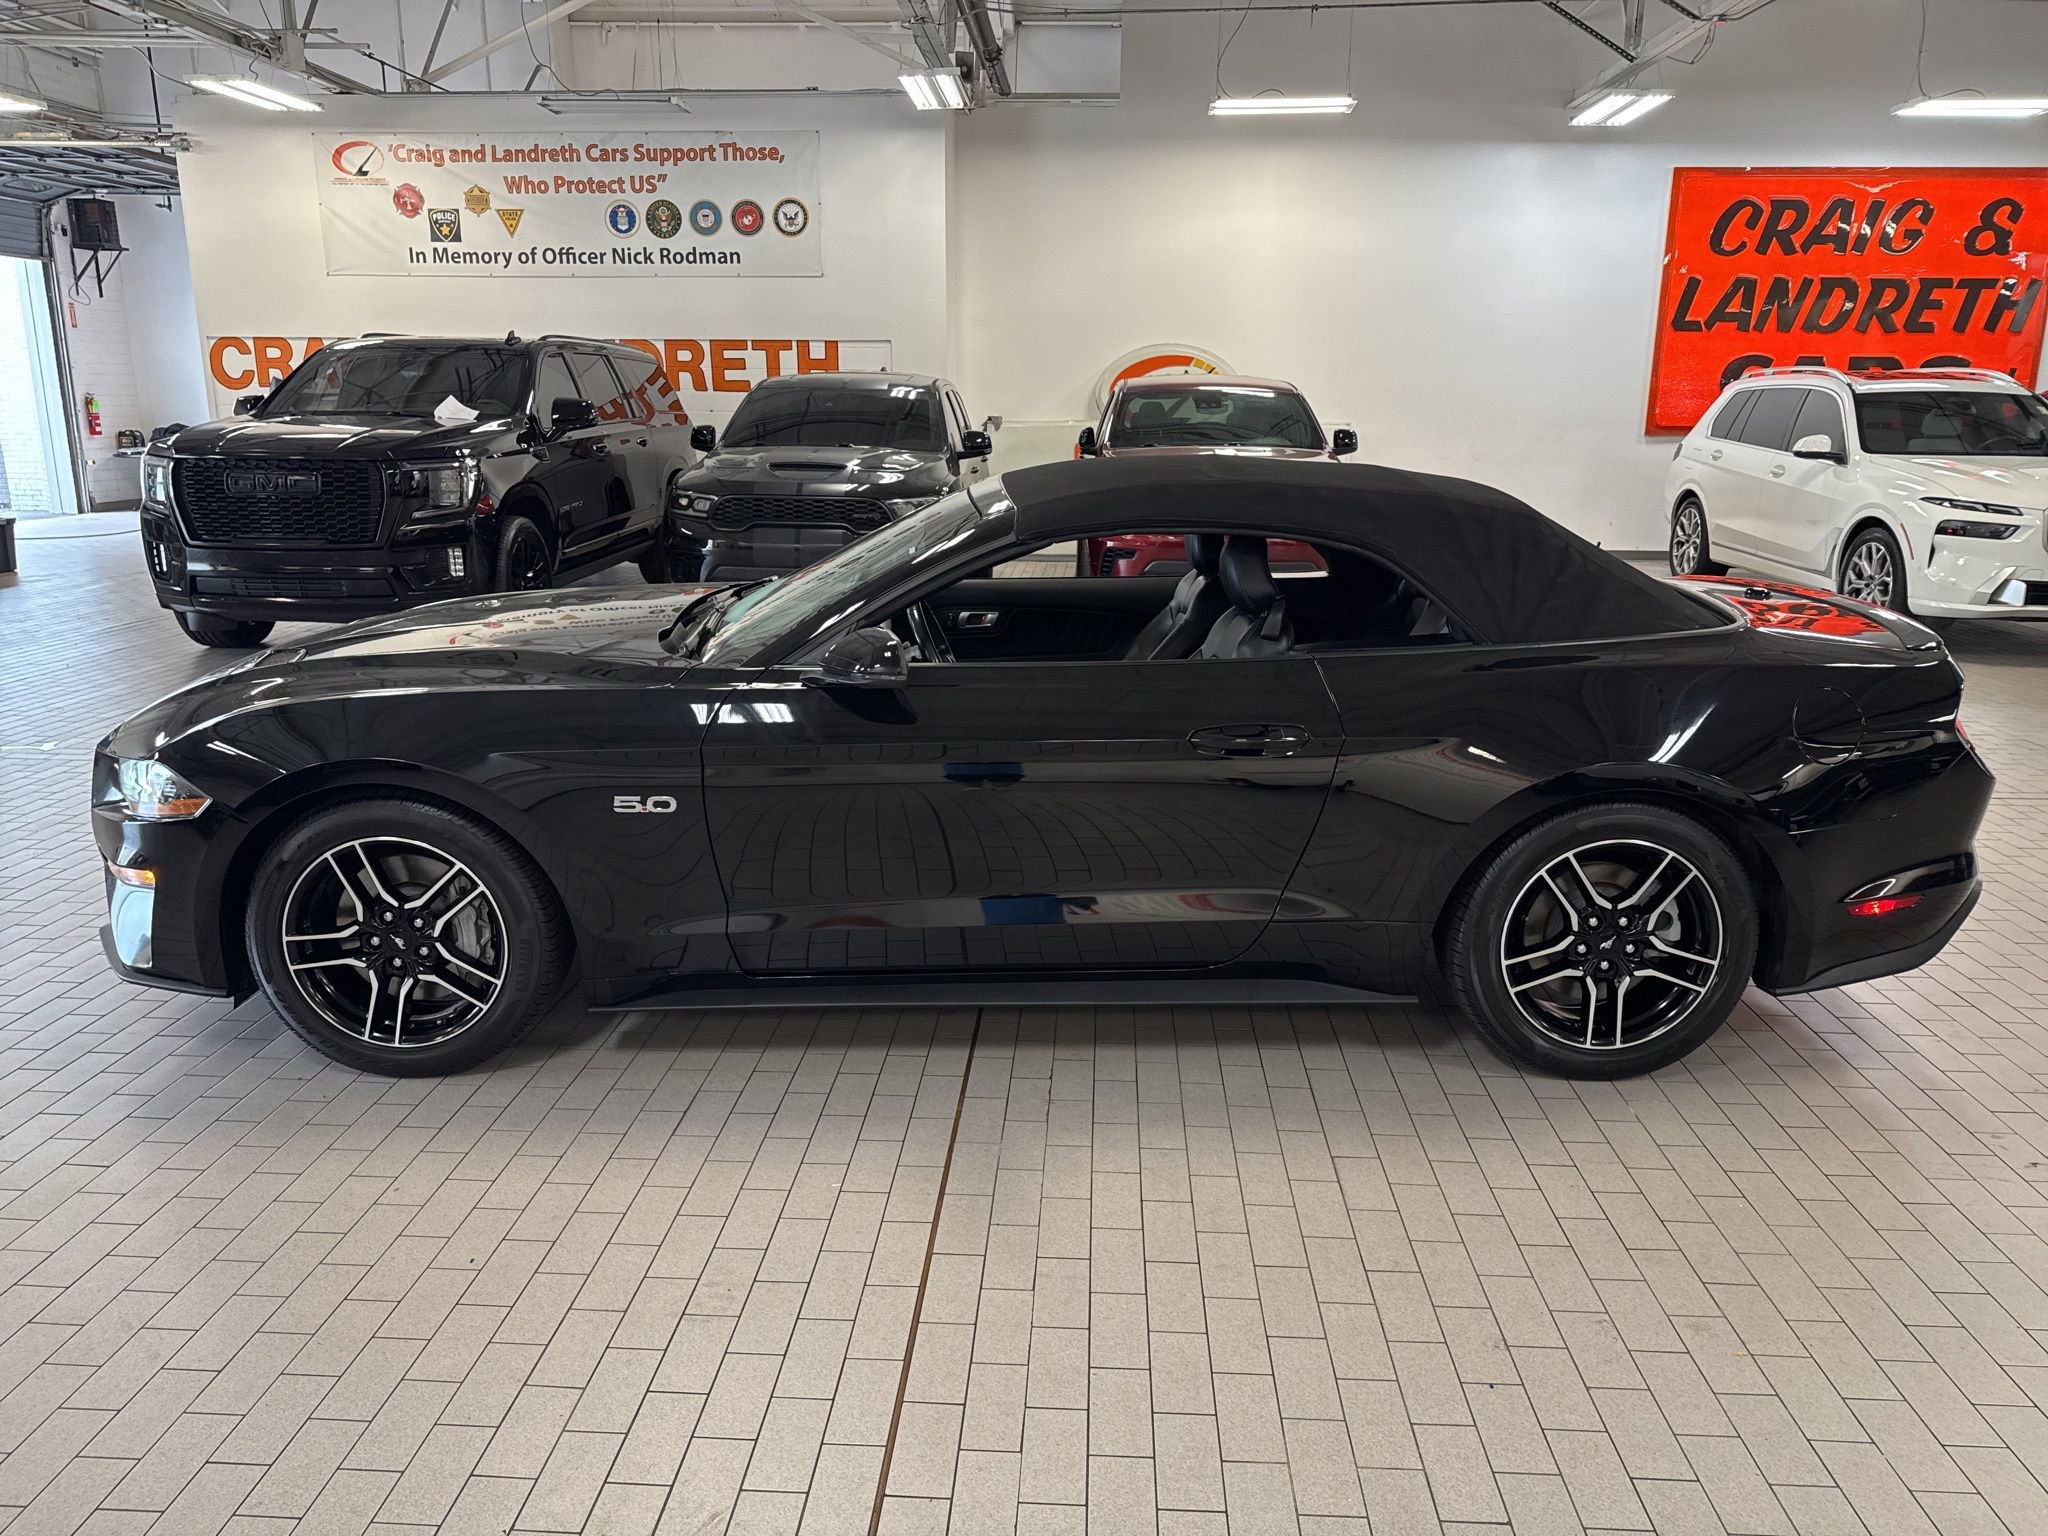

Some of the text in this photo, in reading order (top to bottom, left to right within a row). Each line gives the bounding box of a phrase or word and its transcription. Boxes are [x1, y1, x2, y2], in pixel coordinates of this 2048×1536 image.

[449, 143, 487, 163] and
[491, 143, 581, 163] Landreth
[585, 143, 629, 163] Cars
[633, 143, 717, 167] Support
[718, 142, 785, 164] Those,
[503, 174, 550, 194] Who
[553, 175, 626, 194] Protect
[432, 211, 456, 222] POLICE
[1708, 197, 2025, 257] CRAIG &
[408, 246, 742, 270] In Memory of Officer Nick Rodman
[1671, 276, 2043, 335] LANDRETH
[227, 472, 317, 494] GMC
[612, 795, 678, 813] 5.0
